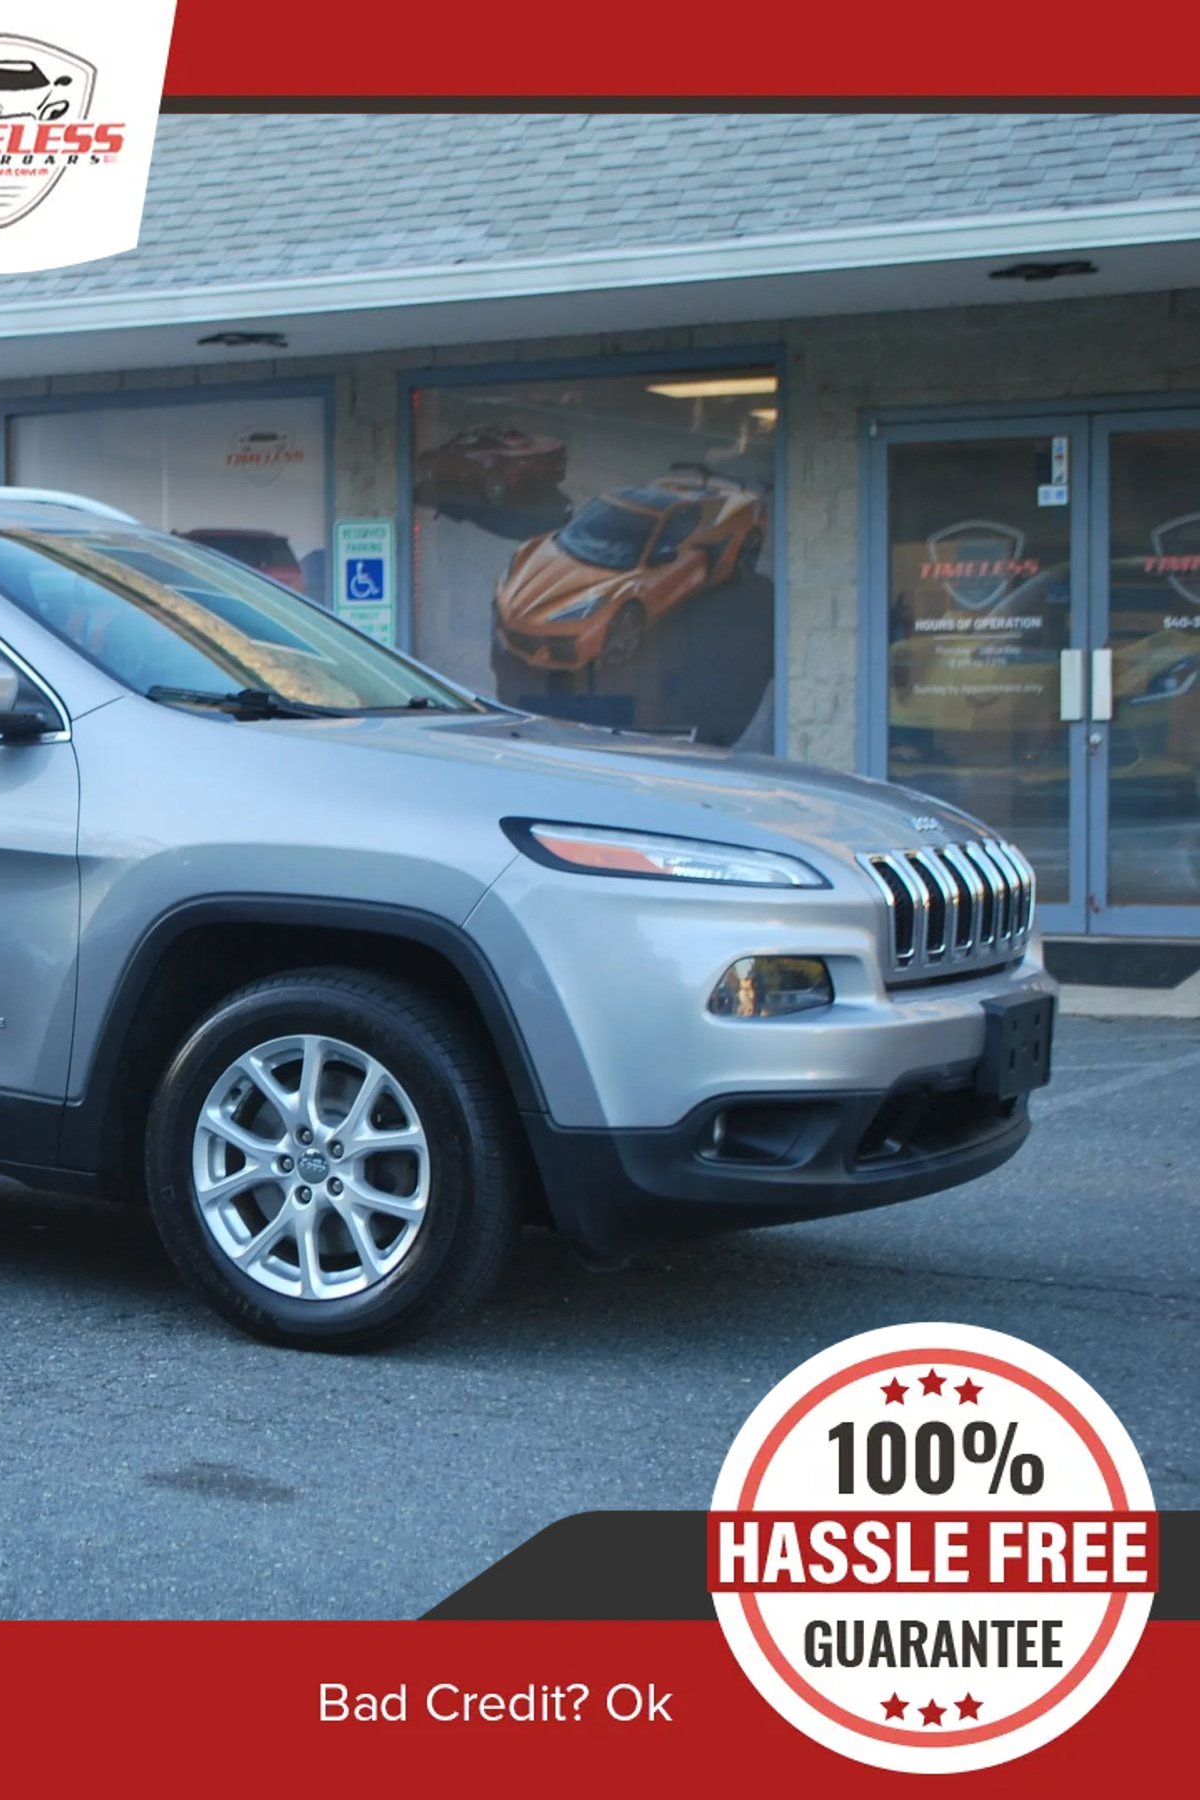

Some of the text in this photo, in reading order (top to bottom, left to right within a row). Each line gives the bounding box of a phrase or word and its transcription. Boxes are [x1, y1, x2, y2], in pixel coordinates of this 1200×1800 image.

[915, 616, 1042, 632] HOURS OF OPERATION
